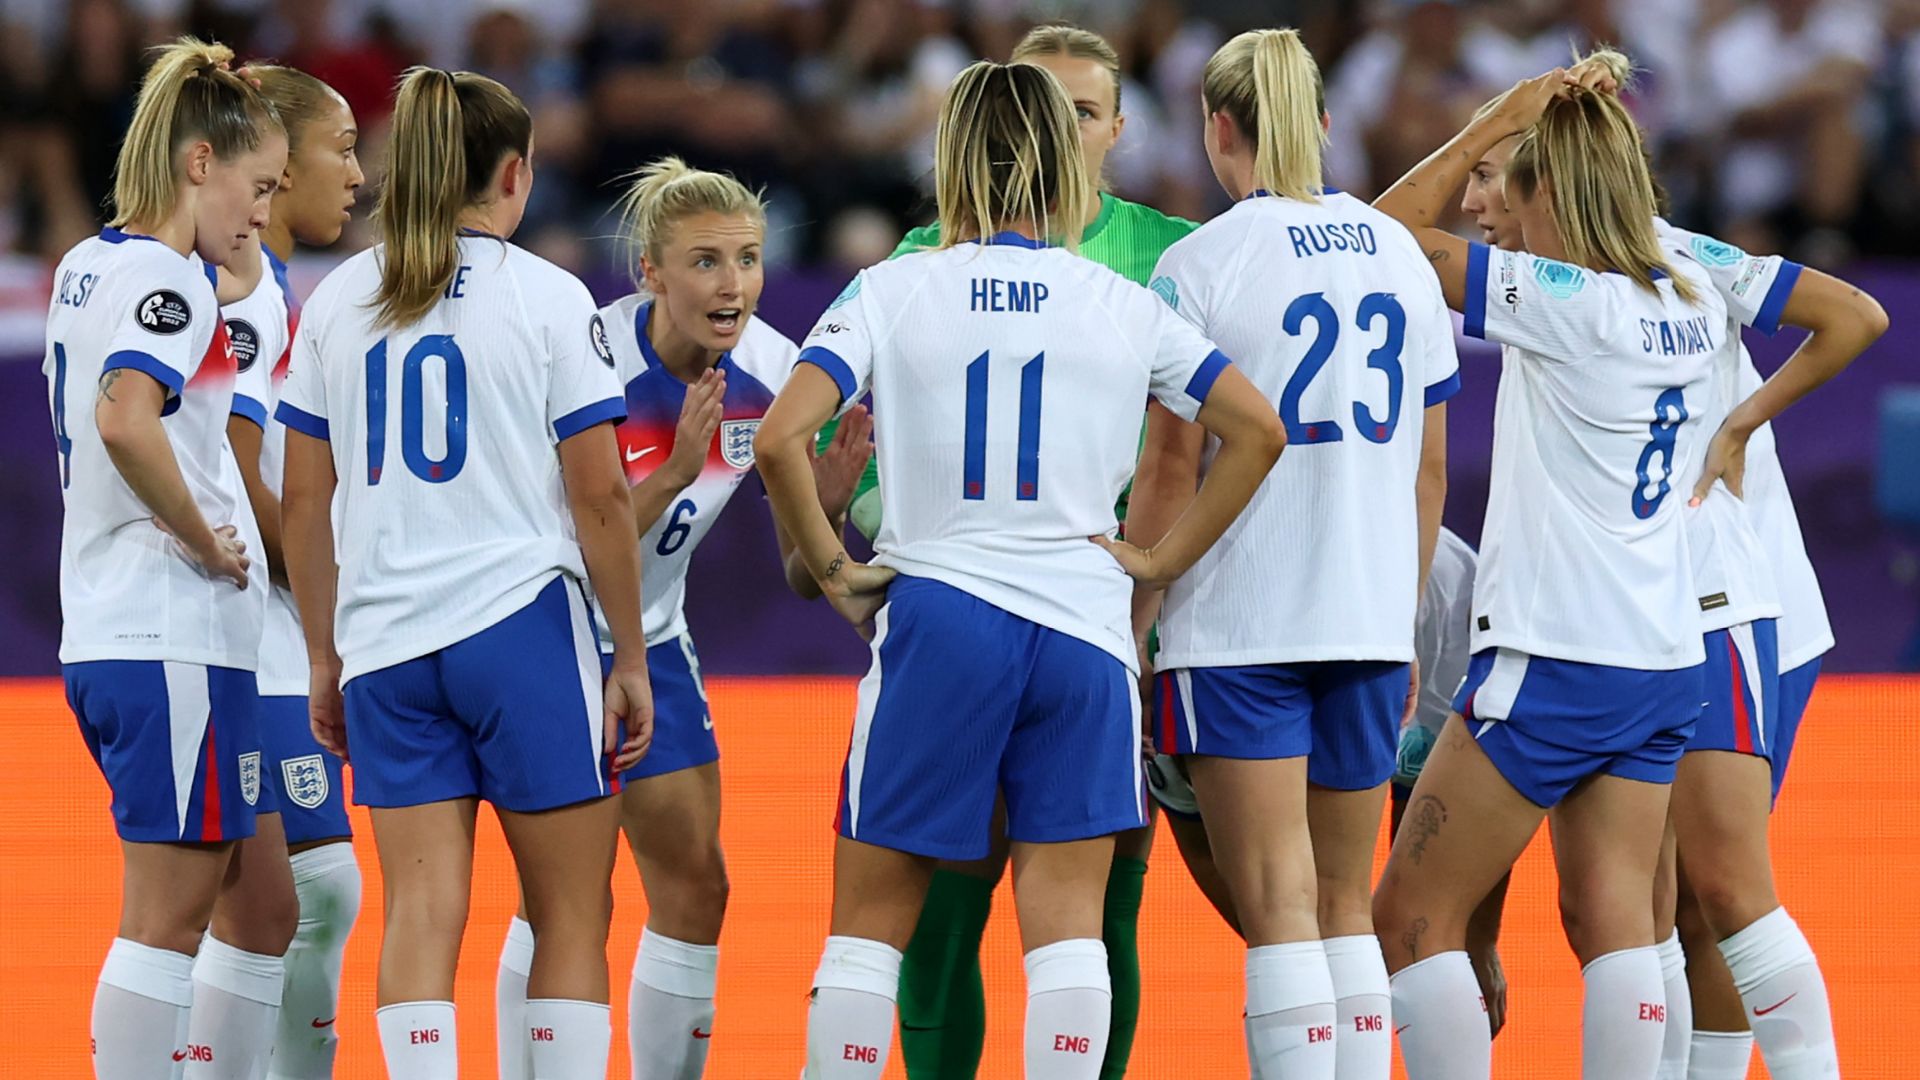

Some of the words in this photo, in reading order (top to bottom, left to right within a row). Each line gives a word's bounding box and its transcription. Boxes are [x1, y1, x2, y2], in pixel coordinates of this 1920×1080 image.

[1286, 223, 1377, 258] RUSSO
[970, 277, 1049, 314] HEMP
[1279, 291, 1407, 447] 23
[365, 334, 468, 487] 10
[962, 349, 1045, 501] 11
[1631, 386, 1689, 520] 8
[656, 498, 698, 556] 6
[1355, 1016, 1382, 1031] ENG
[1639, 1003, 1664, 1022] ENG
[411, 1029, 438, 1044] ENG
[531, 1028, 553, 1041] ENG
[1054, 1035, 1089, 1053] ENG
[1308, 1026, 1331, 1042] ENG
[844, 1044, 877, 1063] ENG
